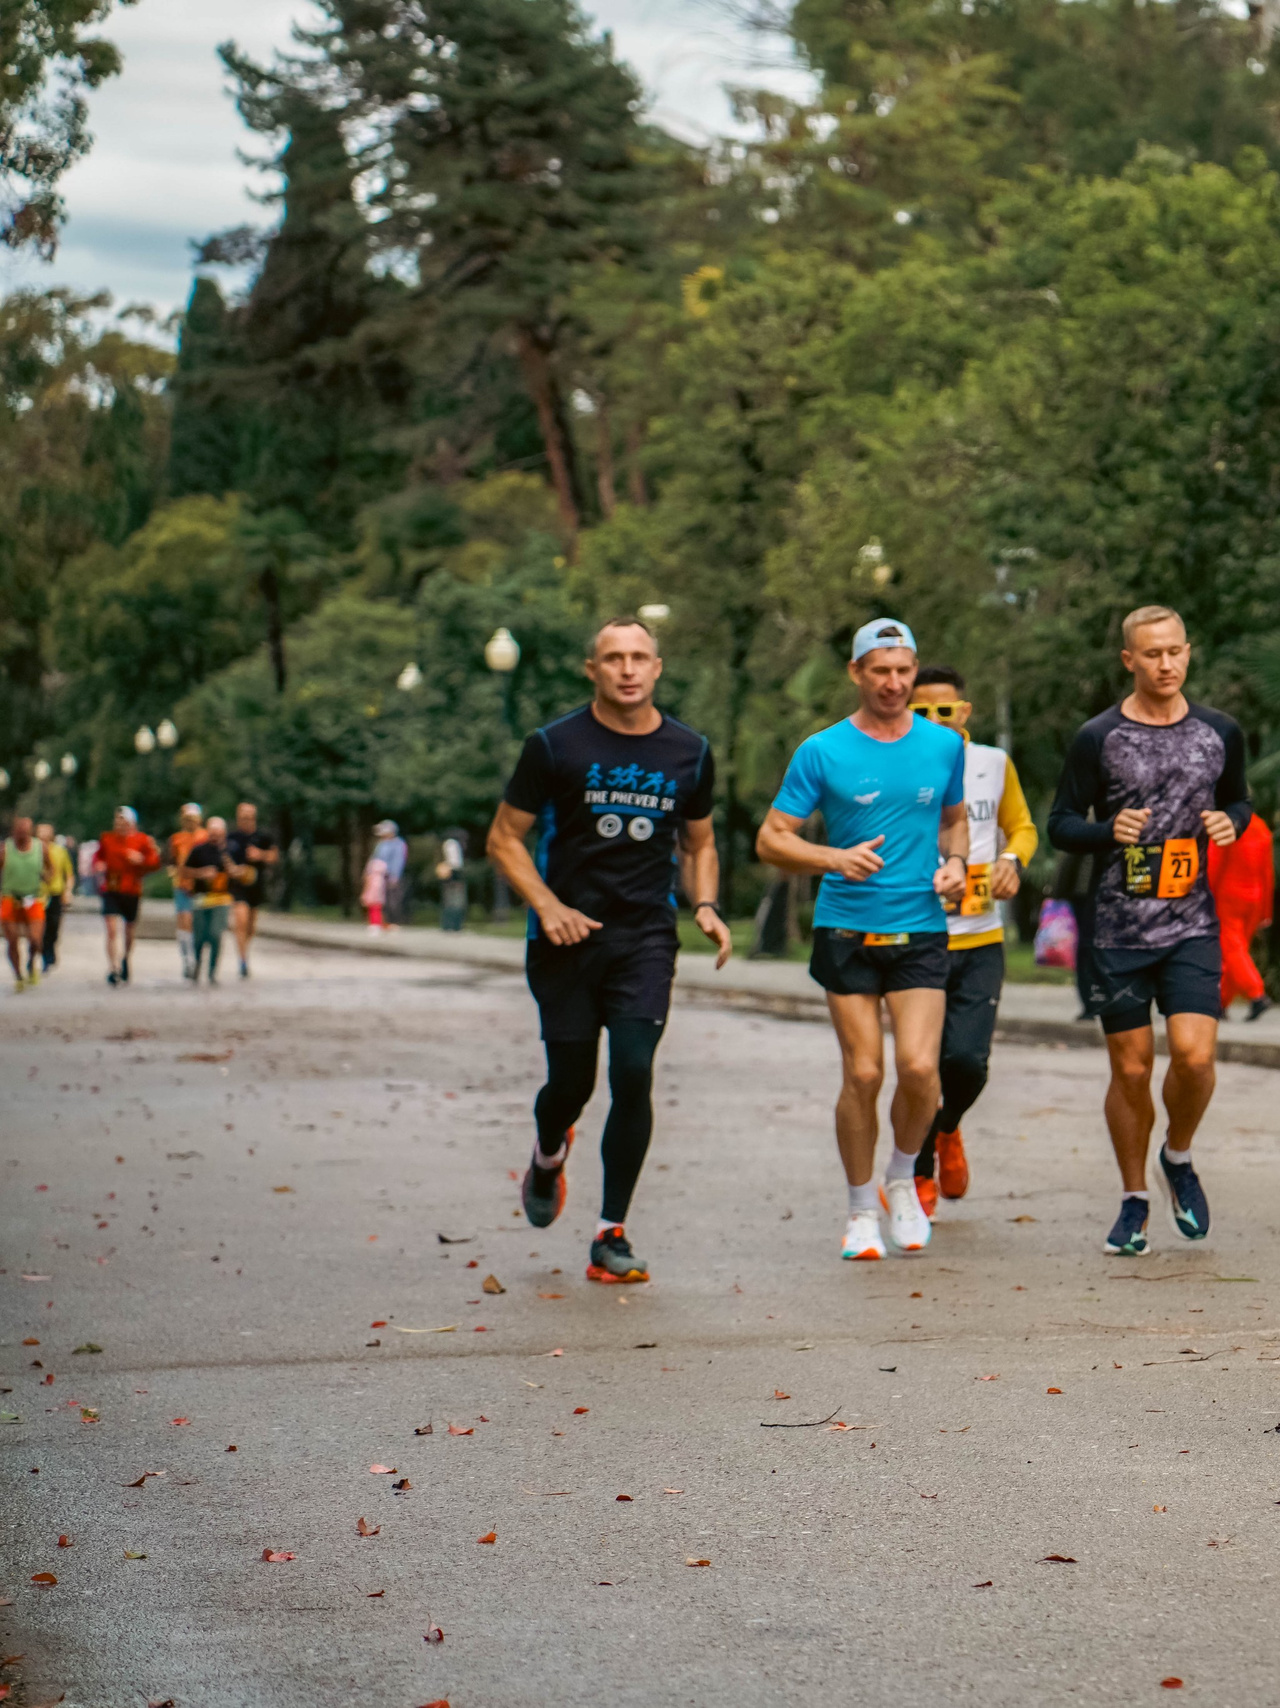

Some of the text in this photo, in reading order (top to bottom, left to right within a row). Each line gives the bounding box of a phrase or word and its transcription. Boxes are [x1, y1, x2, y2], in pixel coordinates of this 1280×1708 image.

[583, 790, 608, 804] THE
[609, 791, 660, 810] PHEVER
[1171, 858, 1192, 878] 27
